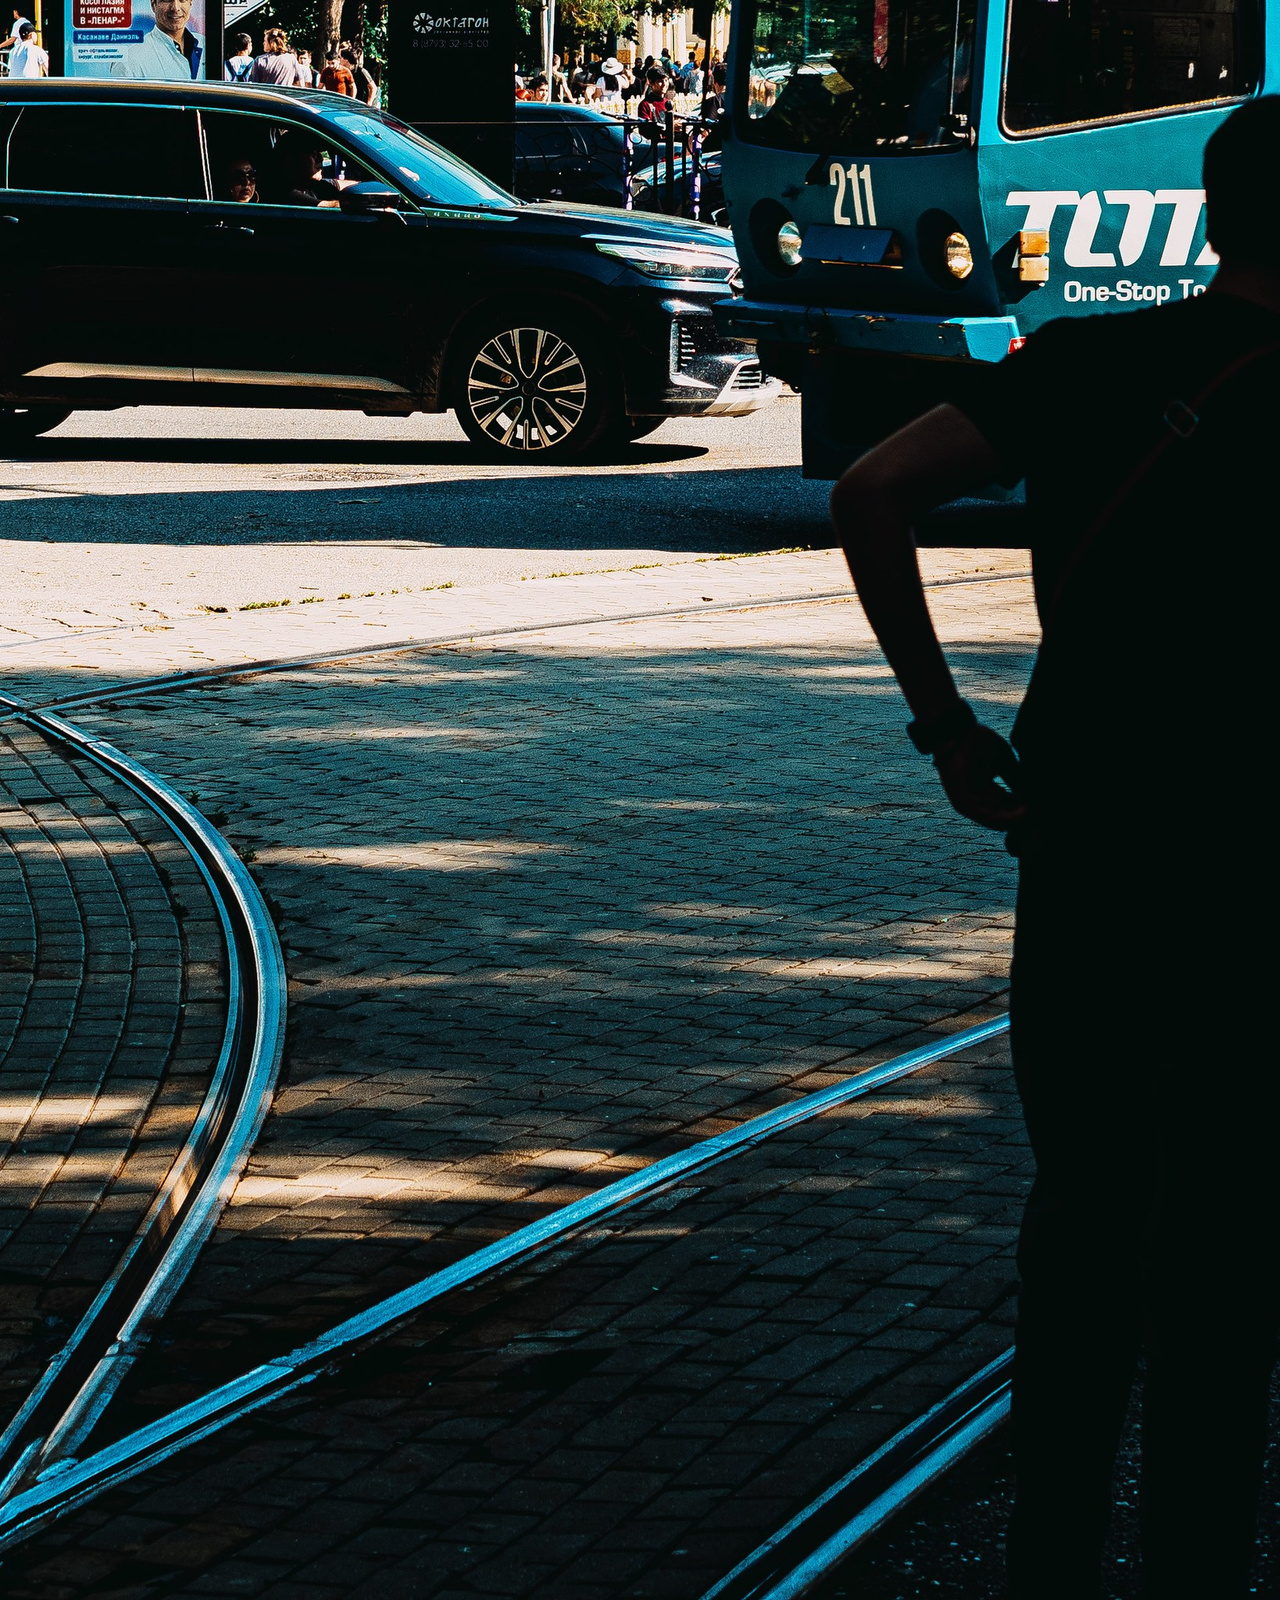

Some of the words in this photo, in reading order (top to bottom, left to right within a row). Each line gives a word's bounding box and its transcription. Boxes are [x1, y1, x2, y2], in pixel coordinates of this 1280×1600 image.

[80, 6, 86, 15] И
[86, 6, 125, 15] НИСТАГМА
[80, 16, 86, 25] В
[111, 33, 140, 41] Даниэль
[829, 162, 877, 226] 211
[1063, 279, 1171, 306] One-Stop
